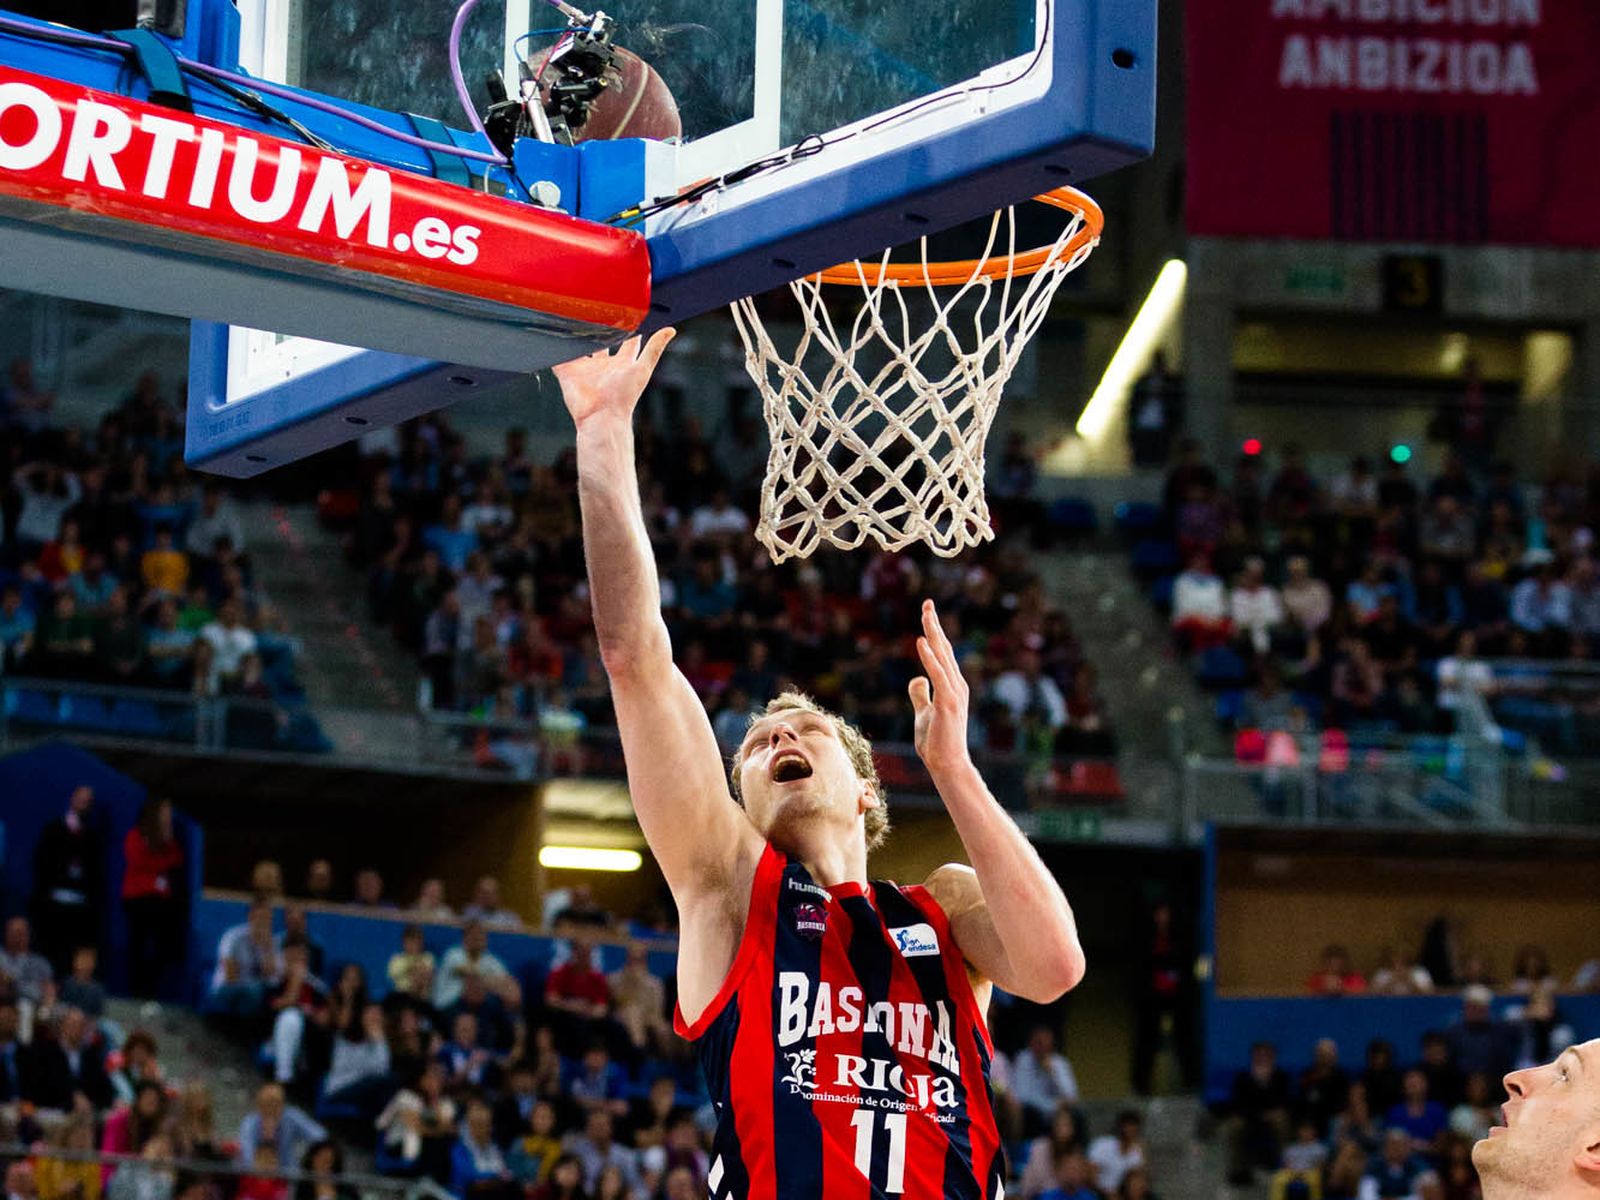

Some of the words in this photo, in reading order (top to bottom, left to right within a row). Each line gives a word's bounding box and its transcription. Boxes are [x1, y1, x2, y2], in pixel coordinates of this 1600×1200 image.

[1280, 35, 1539, 95] ANBIZIOA
[790, 1084, 864, 1105] Dnominación
[865, 1095, 878, 1107] de
[850, 1109, 908, 1195] 11
